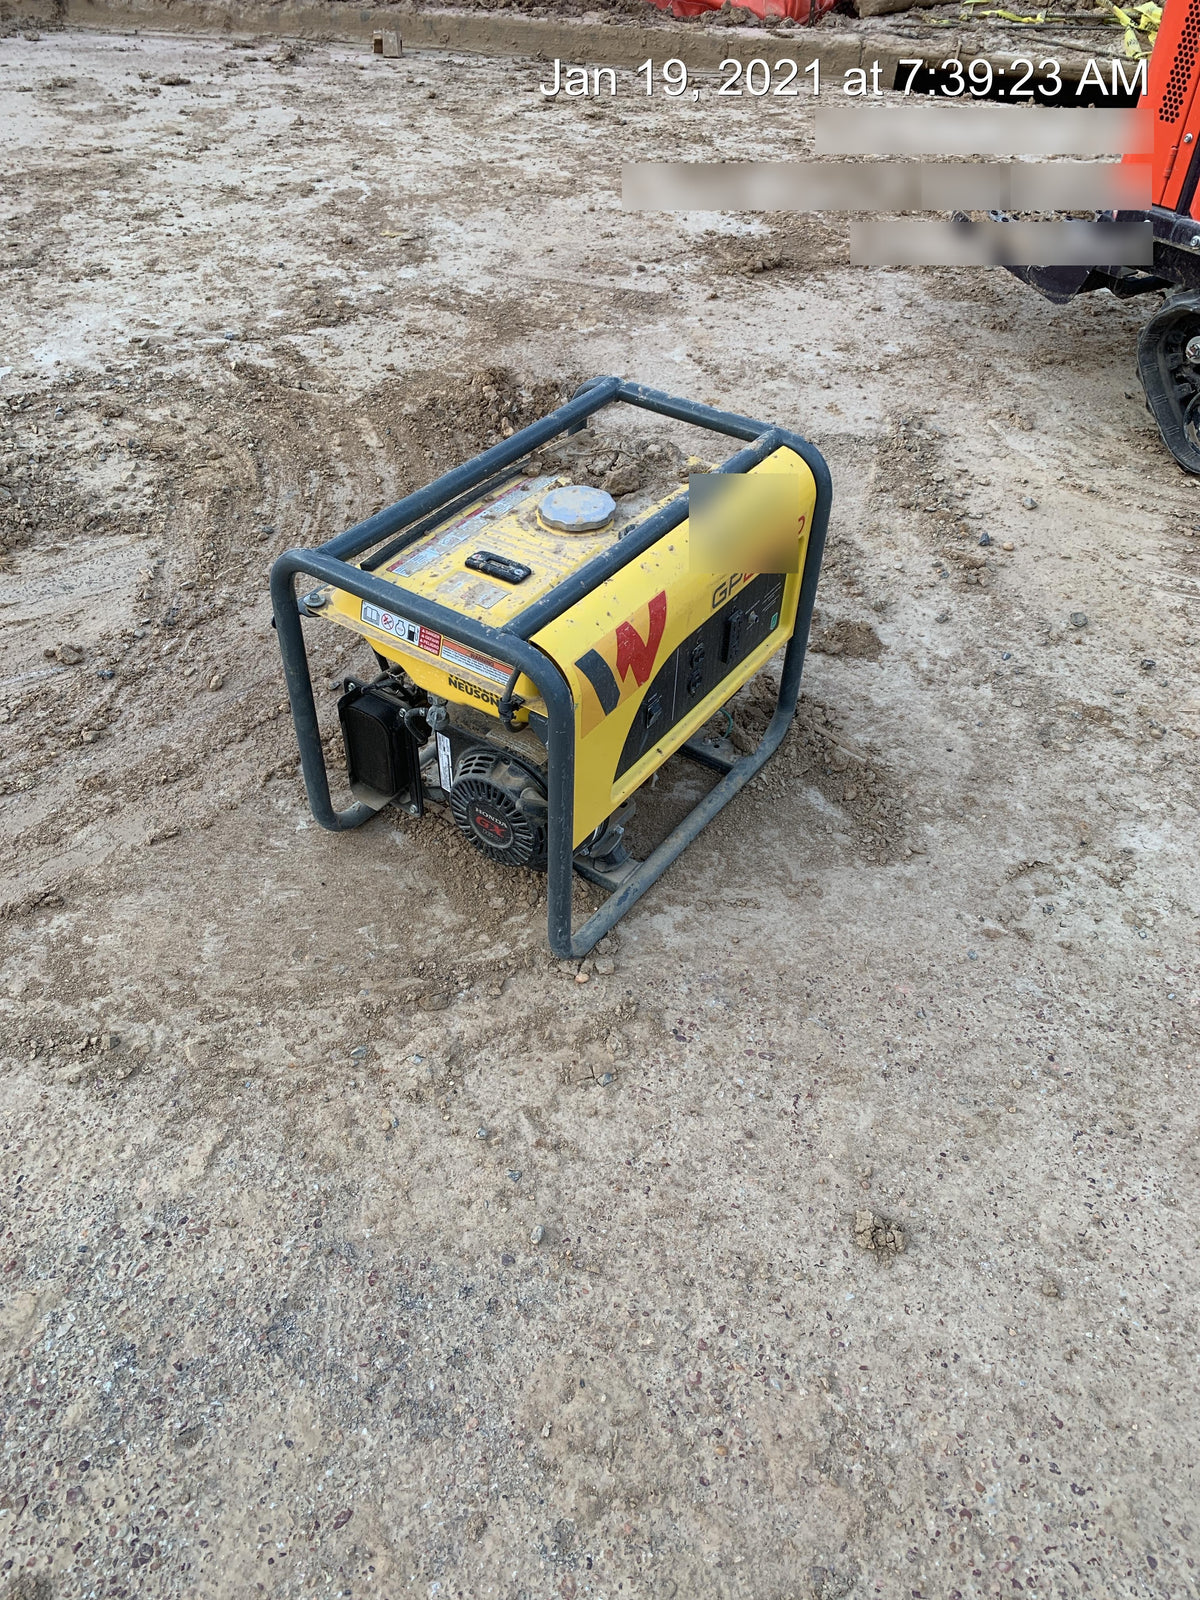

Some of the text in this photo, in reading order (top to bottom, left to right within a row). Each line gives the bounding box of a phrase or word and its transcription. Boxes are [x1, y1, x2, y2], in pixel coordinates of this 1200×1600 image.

[448, 676, 502, 708] NEUSON
[475, 807, 508, 828] HONDA
[475, 816, 506, 838] GX
